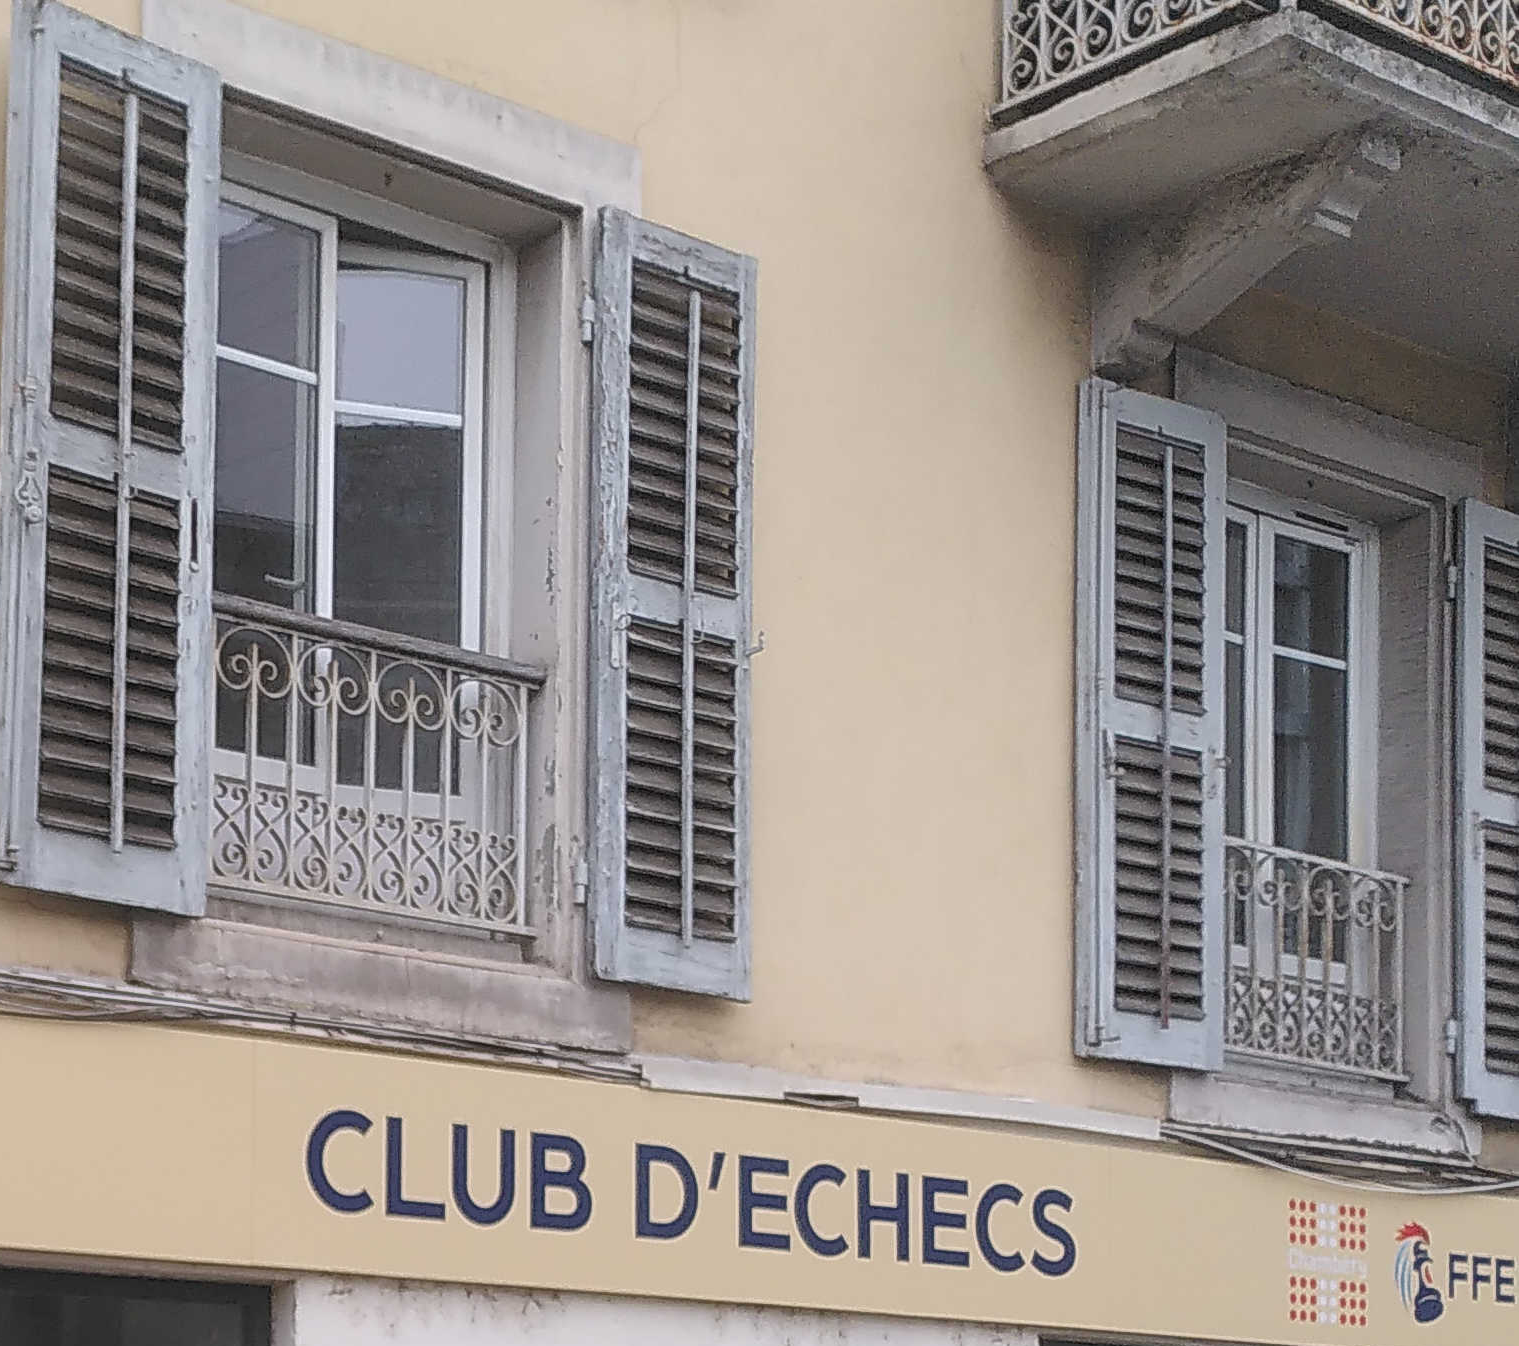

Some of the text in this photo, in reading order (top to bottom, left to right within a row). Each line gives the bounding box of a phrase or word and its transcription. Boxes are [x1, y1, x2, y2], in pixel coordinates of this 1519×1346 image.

[306, 1109, 1077, 1278] CLUB D'ECHECS
[1448, 1252, 1516, 1305] FFE
